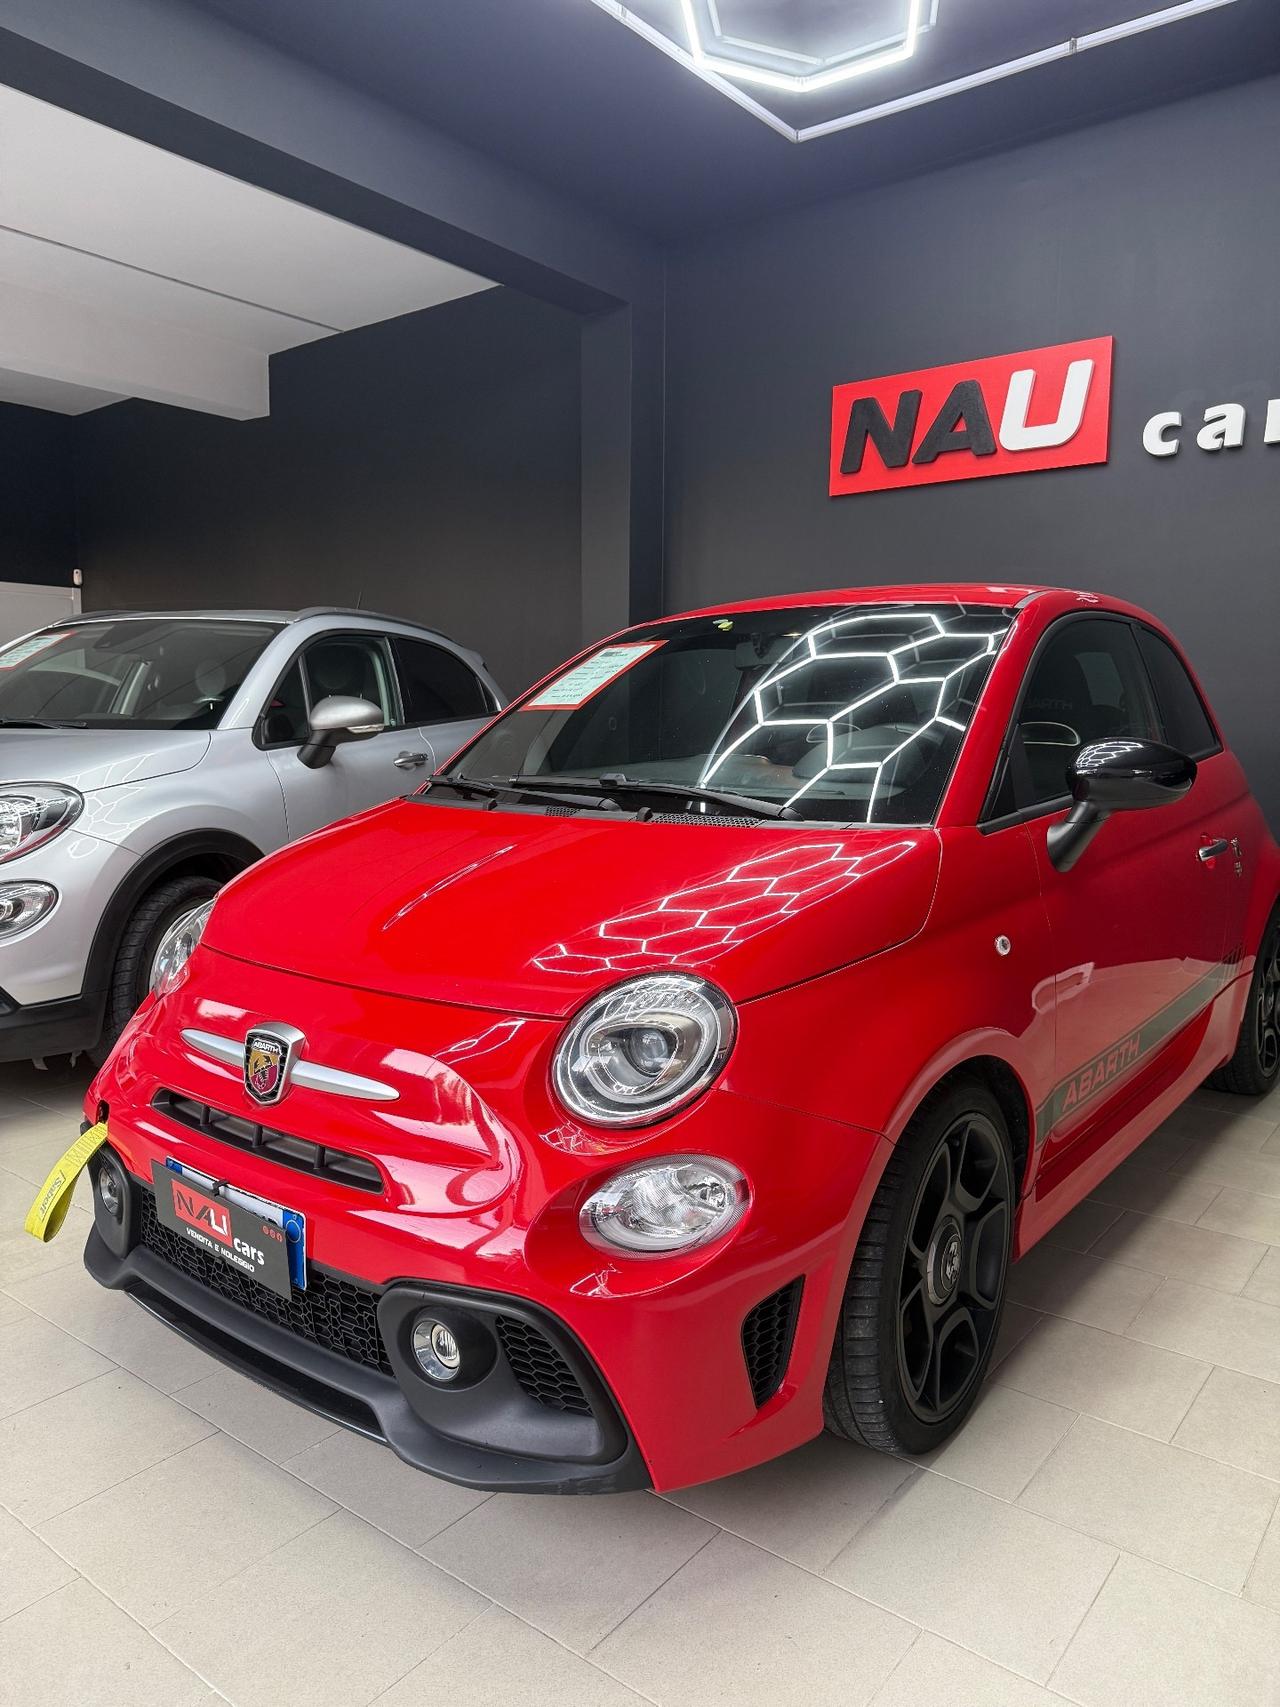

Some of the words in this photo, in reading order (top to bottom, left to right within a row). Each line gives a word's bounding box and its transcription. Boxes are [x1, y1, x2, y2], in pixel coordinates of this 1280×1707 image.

[840, 358, 1094, 475] NAU
[253, 1041, 279, 1054] ABARTH
[1063, 1033, 1141, 1112] ABARTH
[176, 1190, 228, 1237] NAU
[233, 1237, 265, 1265] cars
[186, 1227, 213, 1248] VENDITA
[214, 1243, 220, 1252] E
